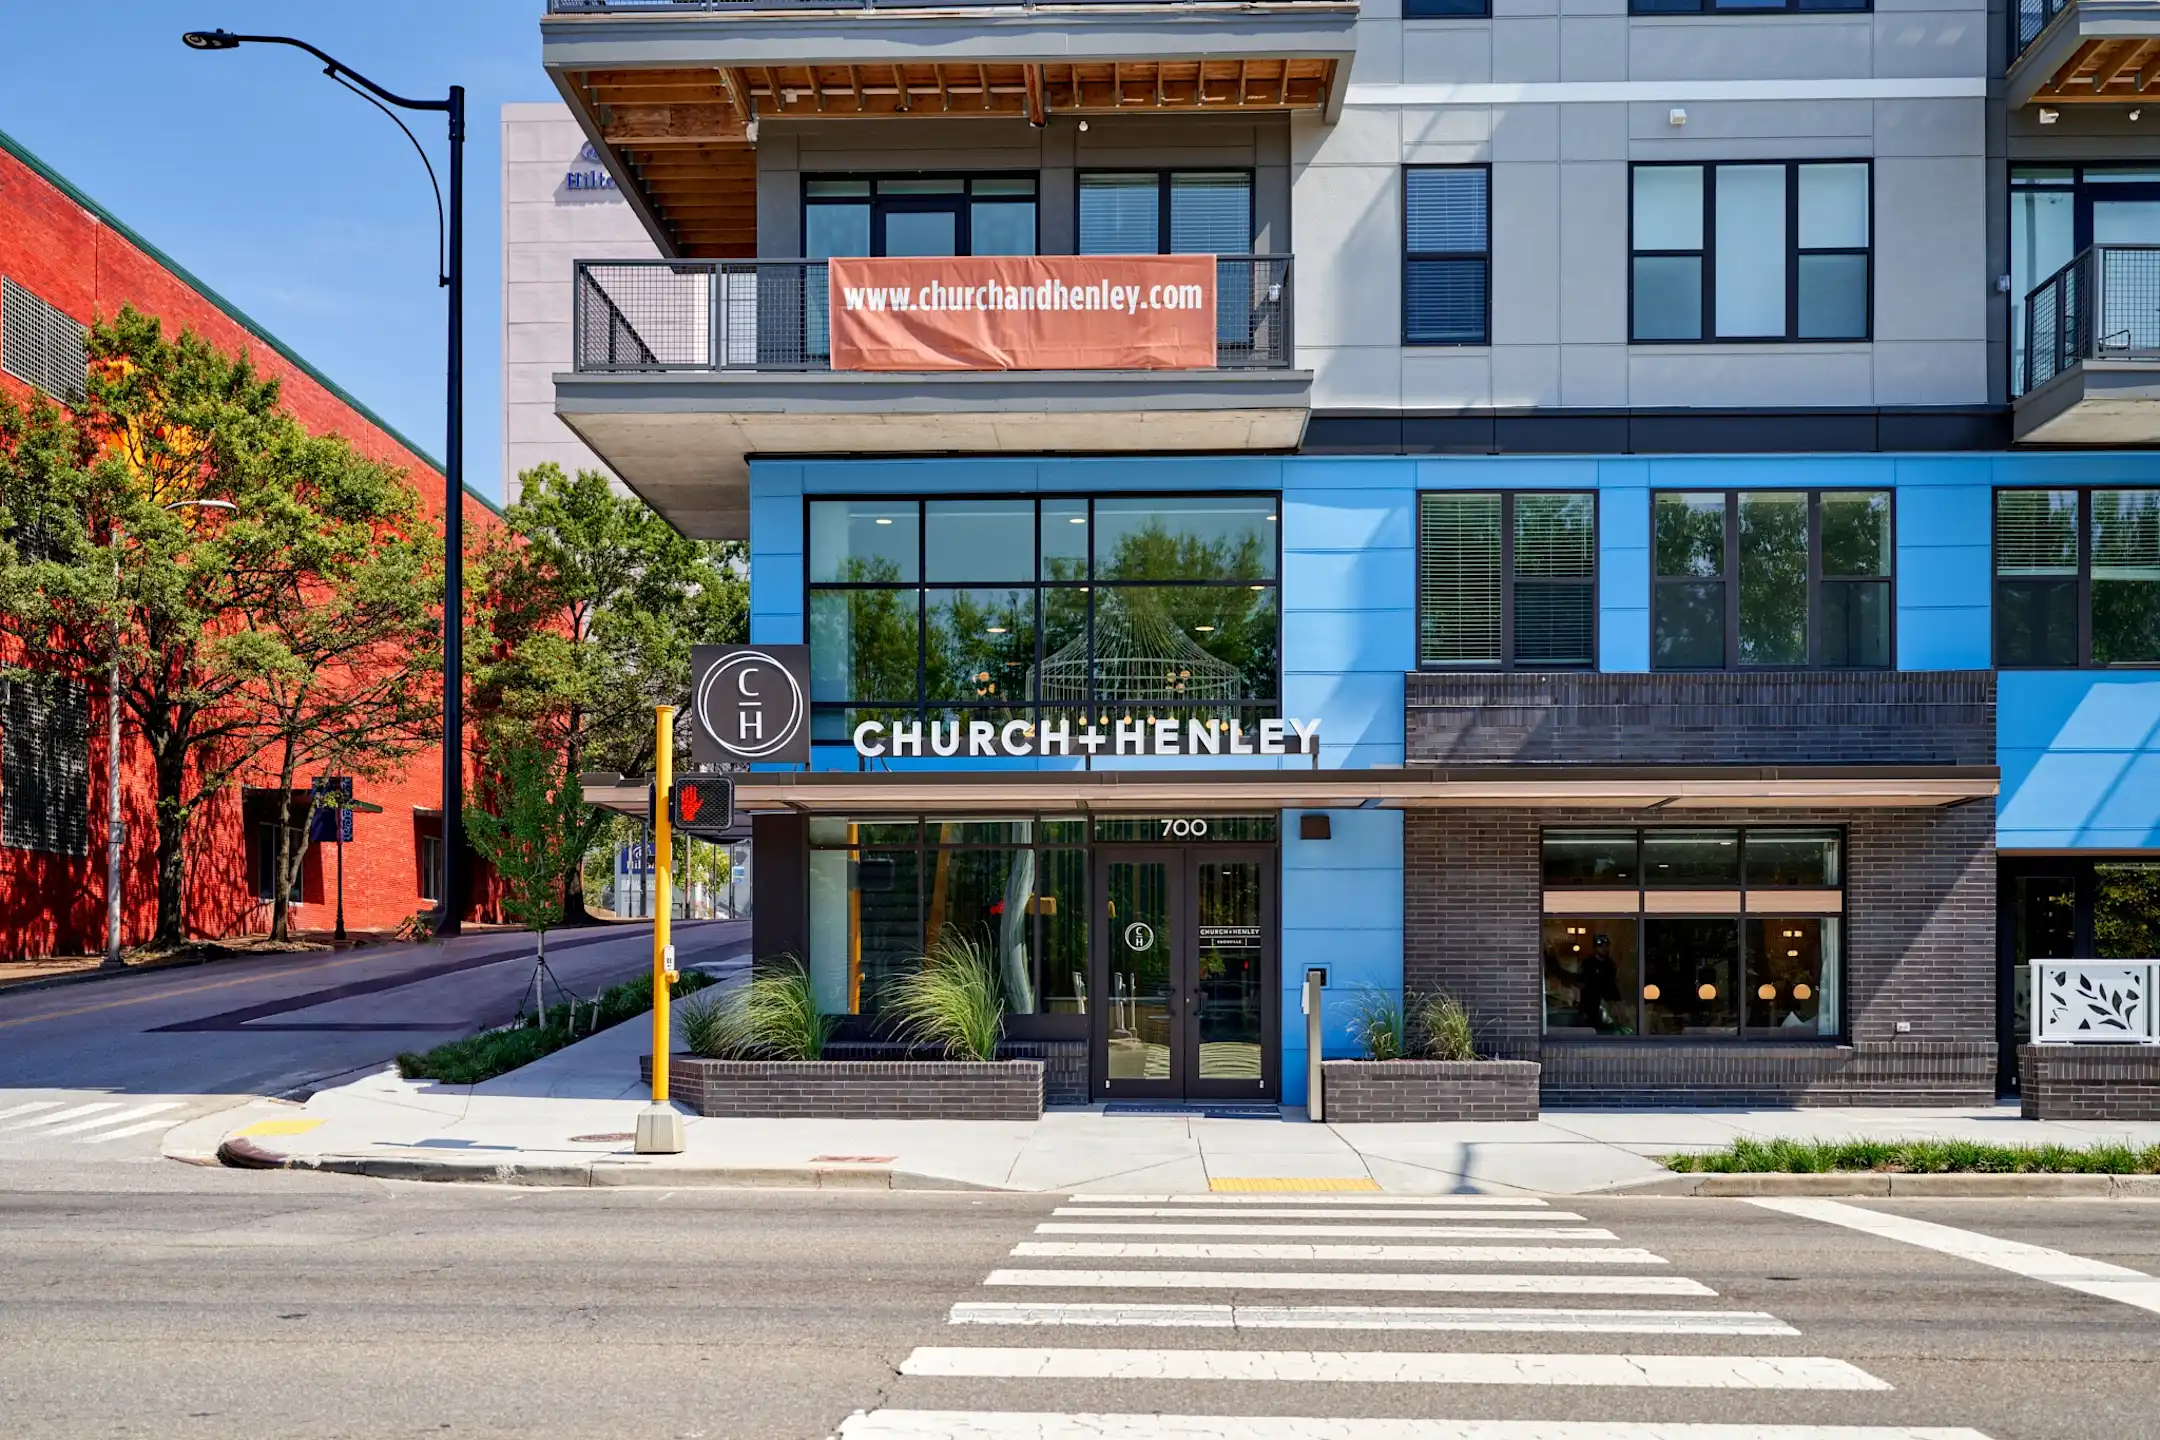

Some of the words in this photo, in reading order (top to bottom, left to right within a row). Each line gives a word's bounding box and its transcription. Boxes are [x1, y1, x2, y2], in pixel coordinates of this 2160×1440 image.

[843, 279, 1203, 315] www.churchandhenley.com
[852, 718, 1322, 757] CHURCH+HENLEY
[1160, 819, 1208, 837] 700
